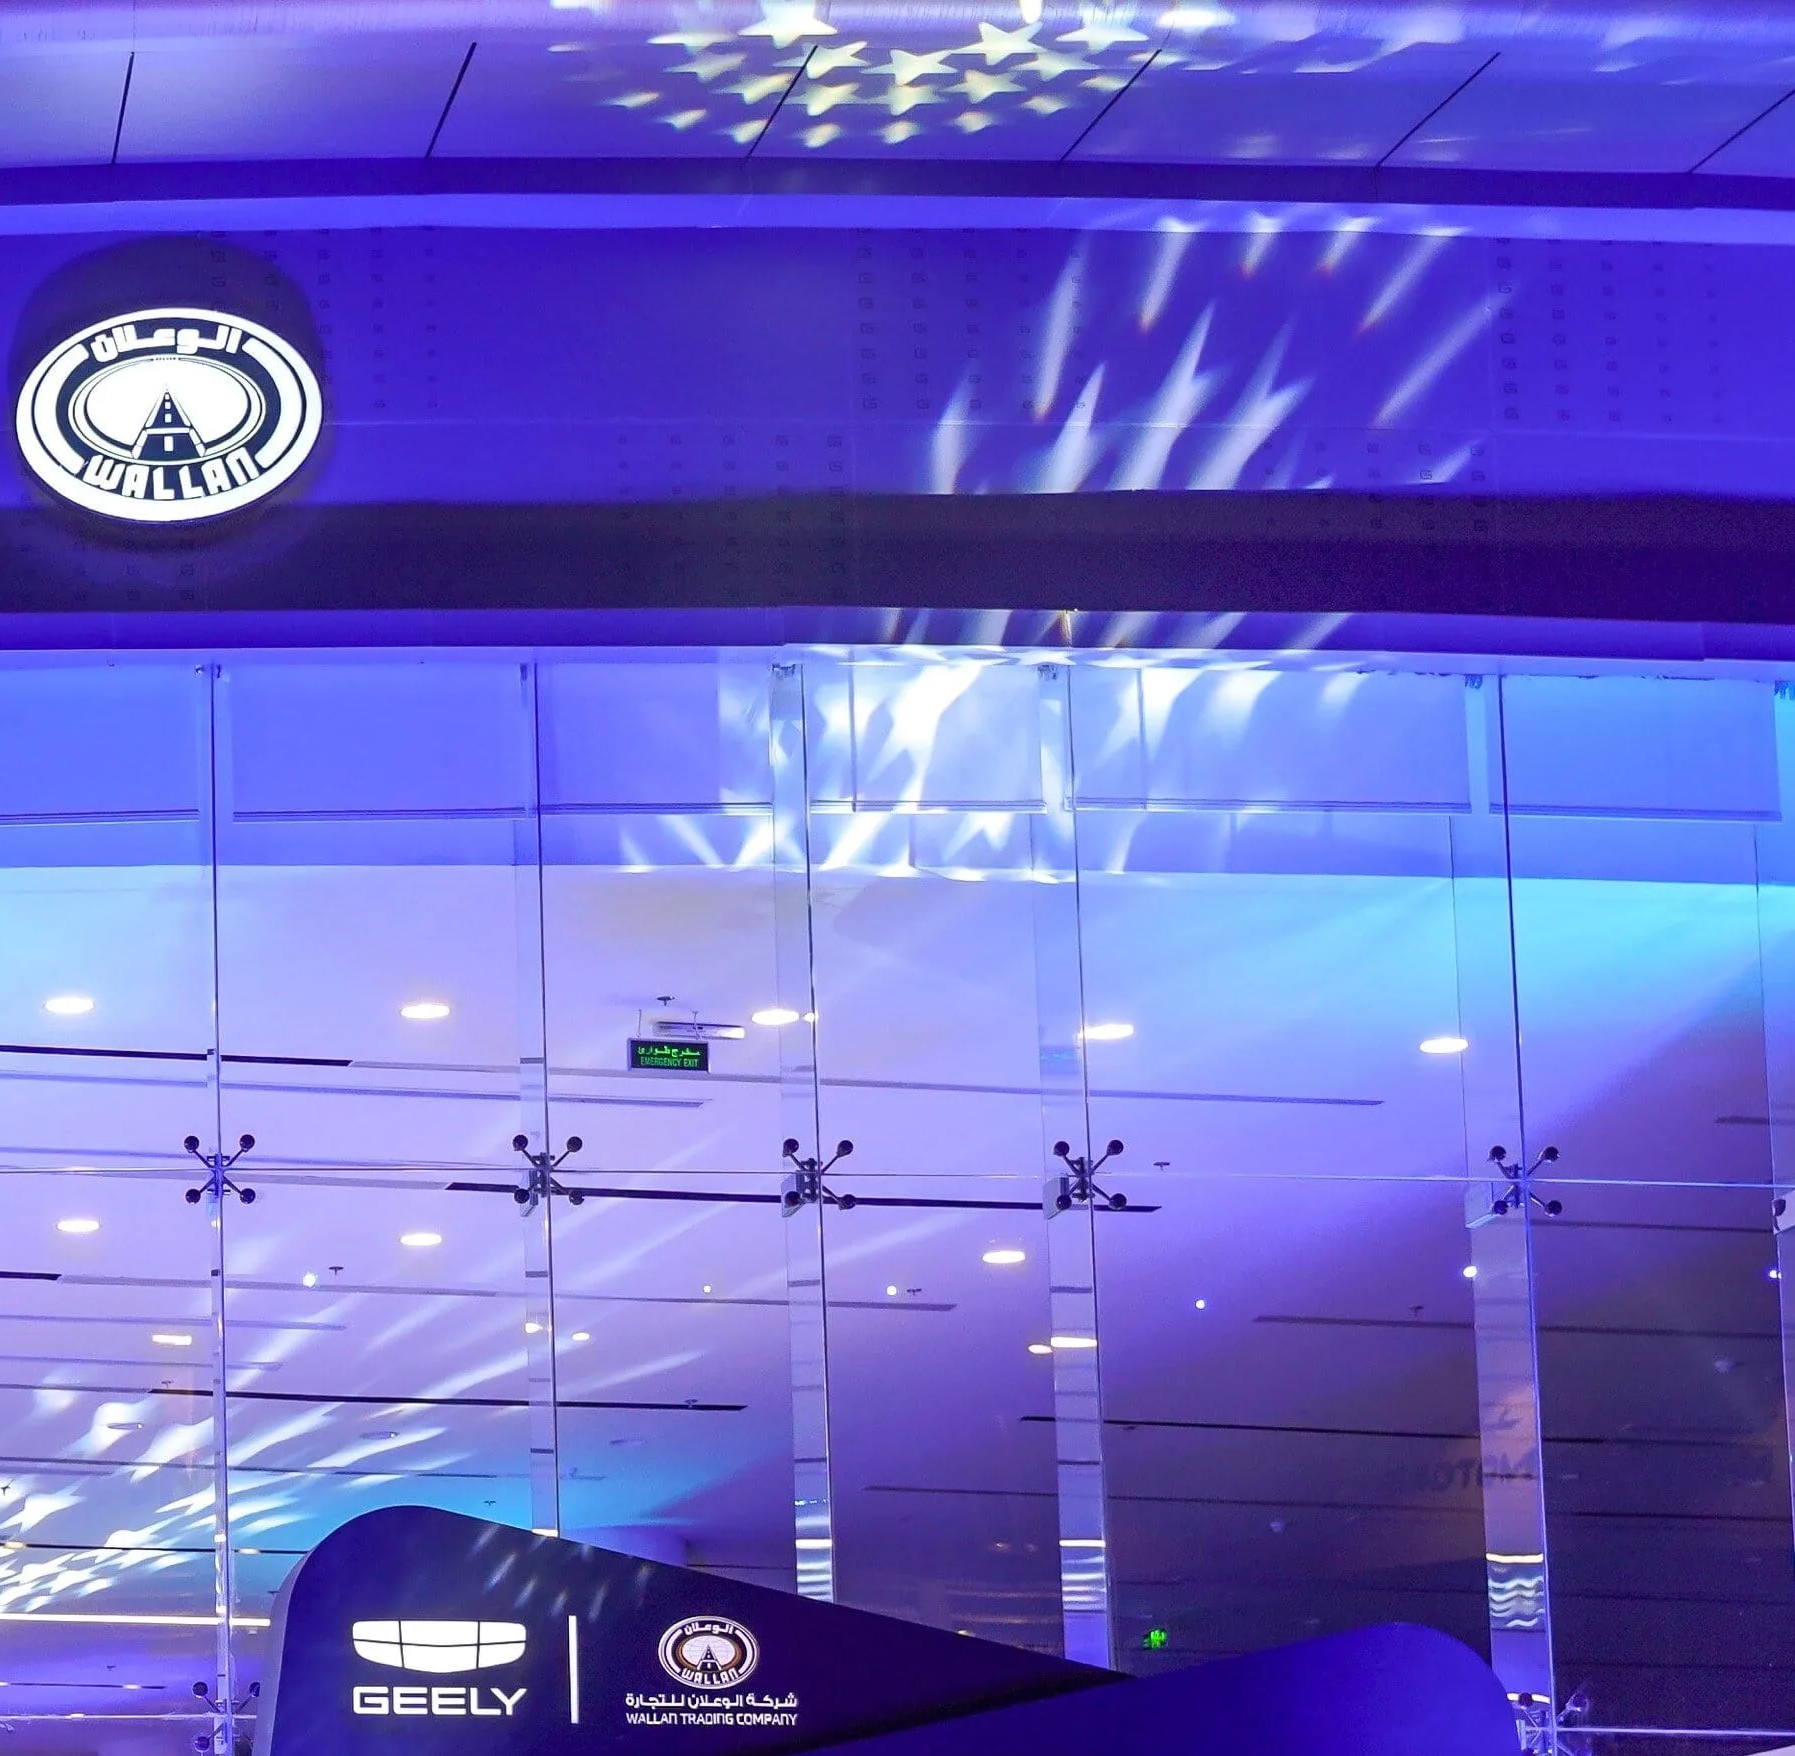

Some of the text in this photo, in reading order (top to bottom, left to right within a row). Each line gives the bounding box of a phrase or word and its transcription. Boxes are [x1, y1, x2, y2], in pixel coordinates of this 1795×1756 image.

[89, 323, 243, 363] الوعلان
[82, 446, 260, 500] WALLAN
[671, 1047, 701, 1058] مخرج
[641, 1057, 699, 1068] EMERGENCY EXIT
[683, 1621, 734, 1636] الوعلان
[681, 1668, 739, 1685] WALLAN
[352, 1685, 528, 1716] GEELY
[625, 1692, 798, 1710] شركة الوعلان للتجارة
[626, 1712, 798, 1727] WALLAN TRADING COMPANY
